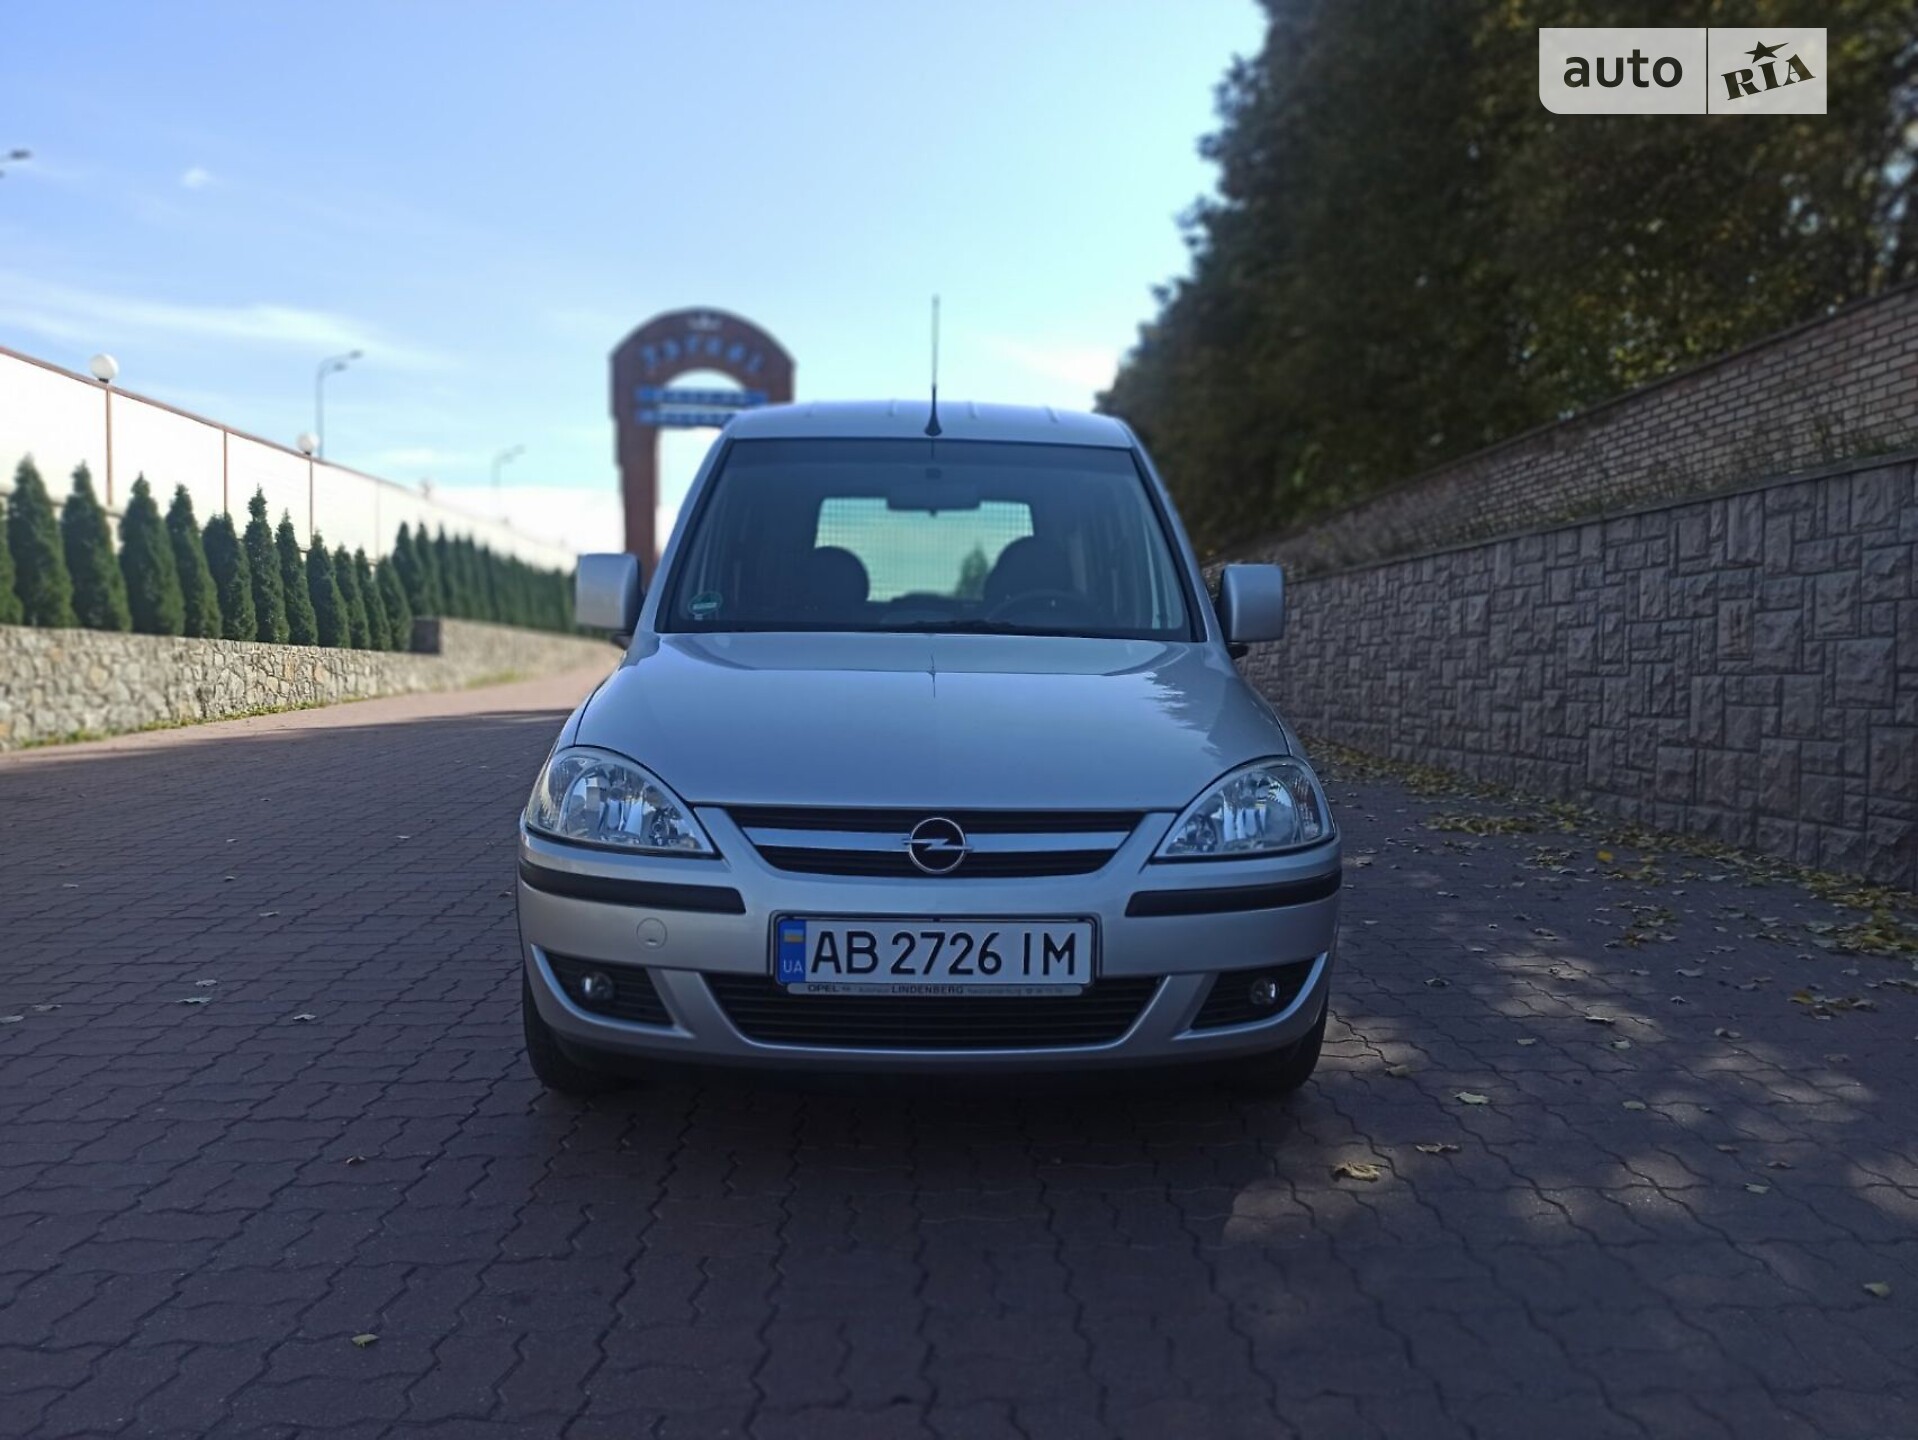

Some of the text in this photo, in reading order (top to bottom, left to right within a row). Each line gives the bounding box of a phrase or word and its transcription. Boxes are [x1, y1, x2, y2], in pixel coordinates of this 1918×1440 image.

[811, 931, 1076, 976] AB 2726 IM
[783, 960, 804, 974] UA
[807, 984, 840, 993] OPEL
[891, 984, 964, 994] LINDENBERG
